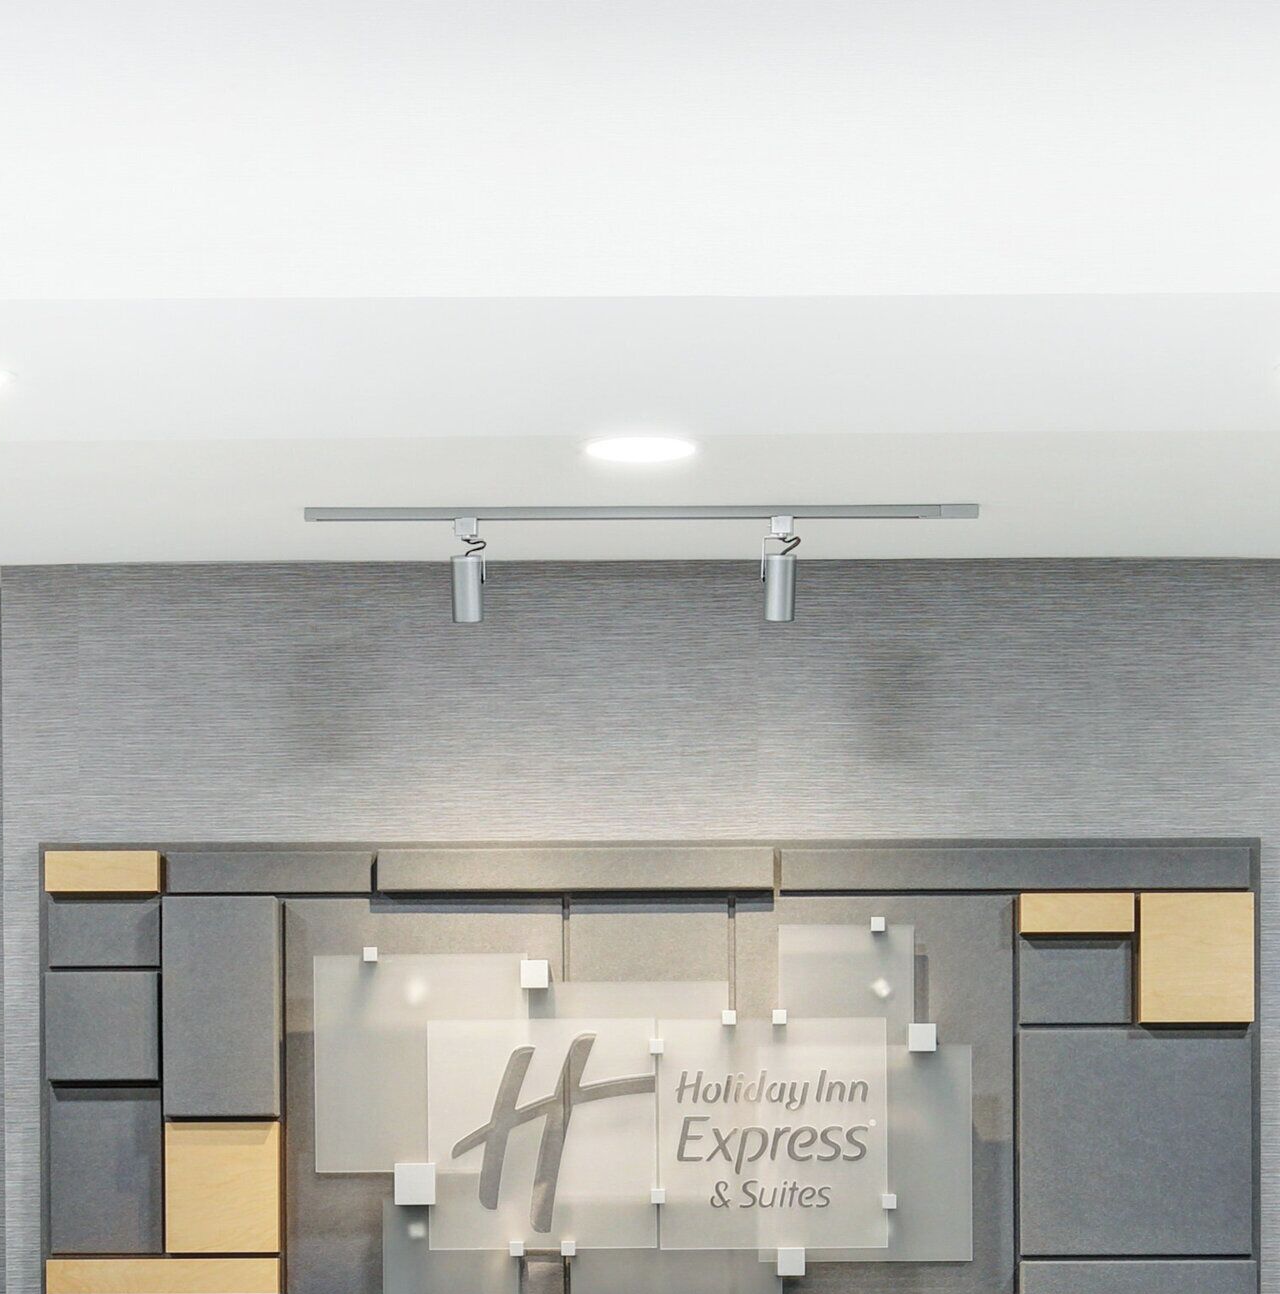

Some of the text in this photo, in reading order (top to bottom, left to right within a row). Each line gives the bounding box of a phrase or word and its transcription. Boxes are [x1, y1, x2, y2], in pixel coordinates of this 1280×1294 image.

[675, 1069, 870, 1112] Holiday Inn
[676, 1116, 870, 1175] Express
[710, 1180, 832, 1208] & Suites
